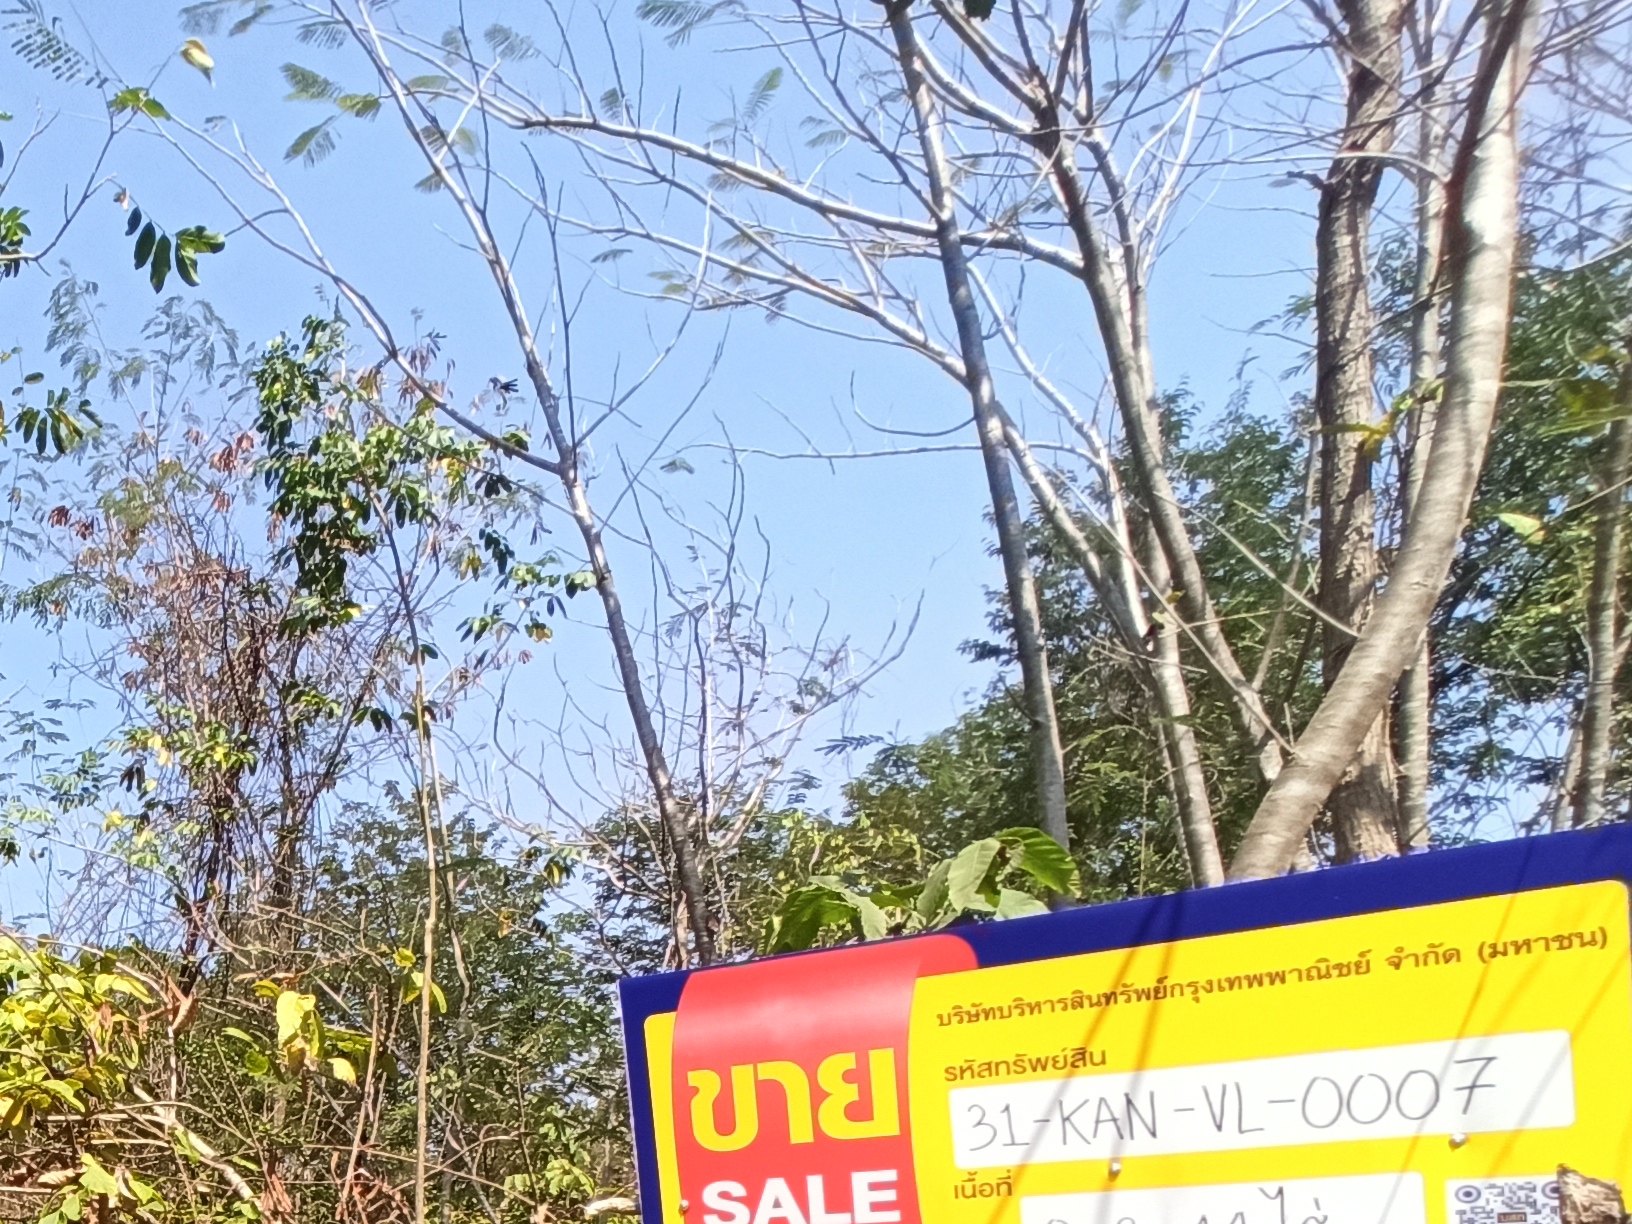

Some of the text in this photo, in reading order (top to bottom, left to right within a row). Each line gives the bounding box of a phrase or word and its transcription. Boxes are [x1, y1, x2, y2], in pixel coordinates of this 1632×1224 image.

[936, 925, 1608, 1027] บริษัทบริหารสินทรัพย์กรุงเทพพาณิชย์ จำกัด (มหาชน)
[686, 1046, 901, 1152] ขาย
[944, 1046, 1107, 1082] รหัสทรัพย์สิน
[967, 1056, 1498, 1151] 31-KAN-VL-0007
[953, 1169, 1013, 1200] เนื้อที่
